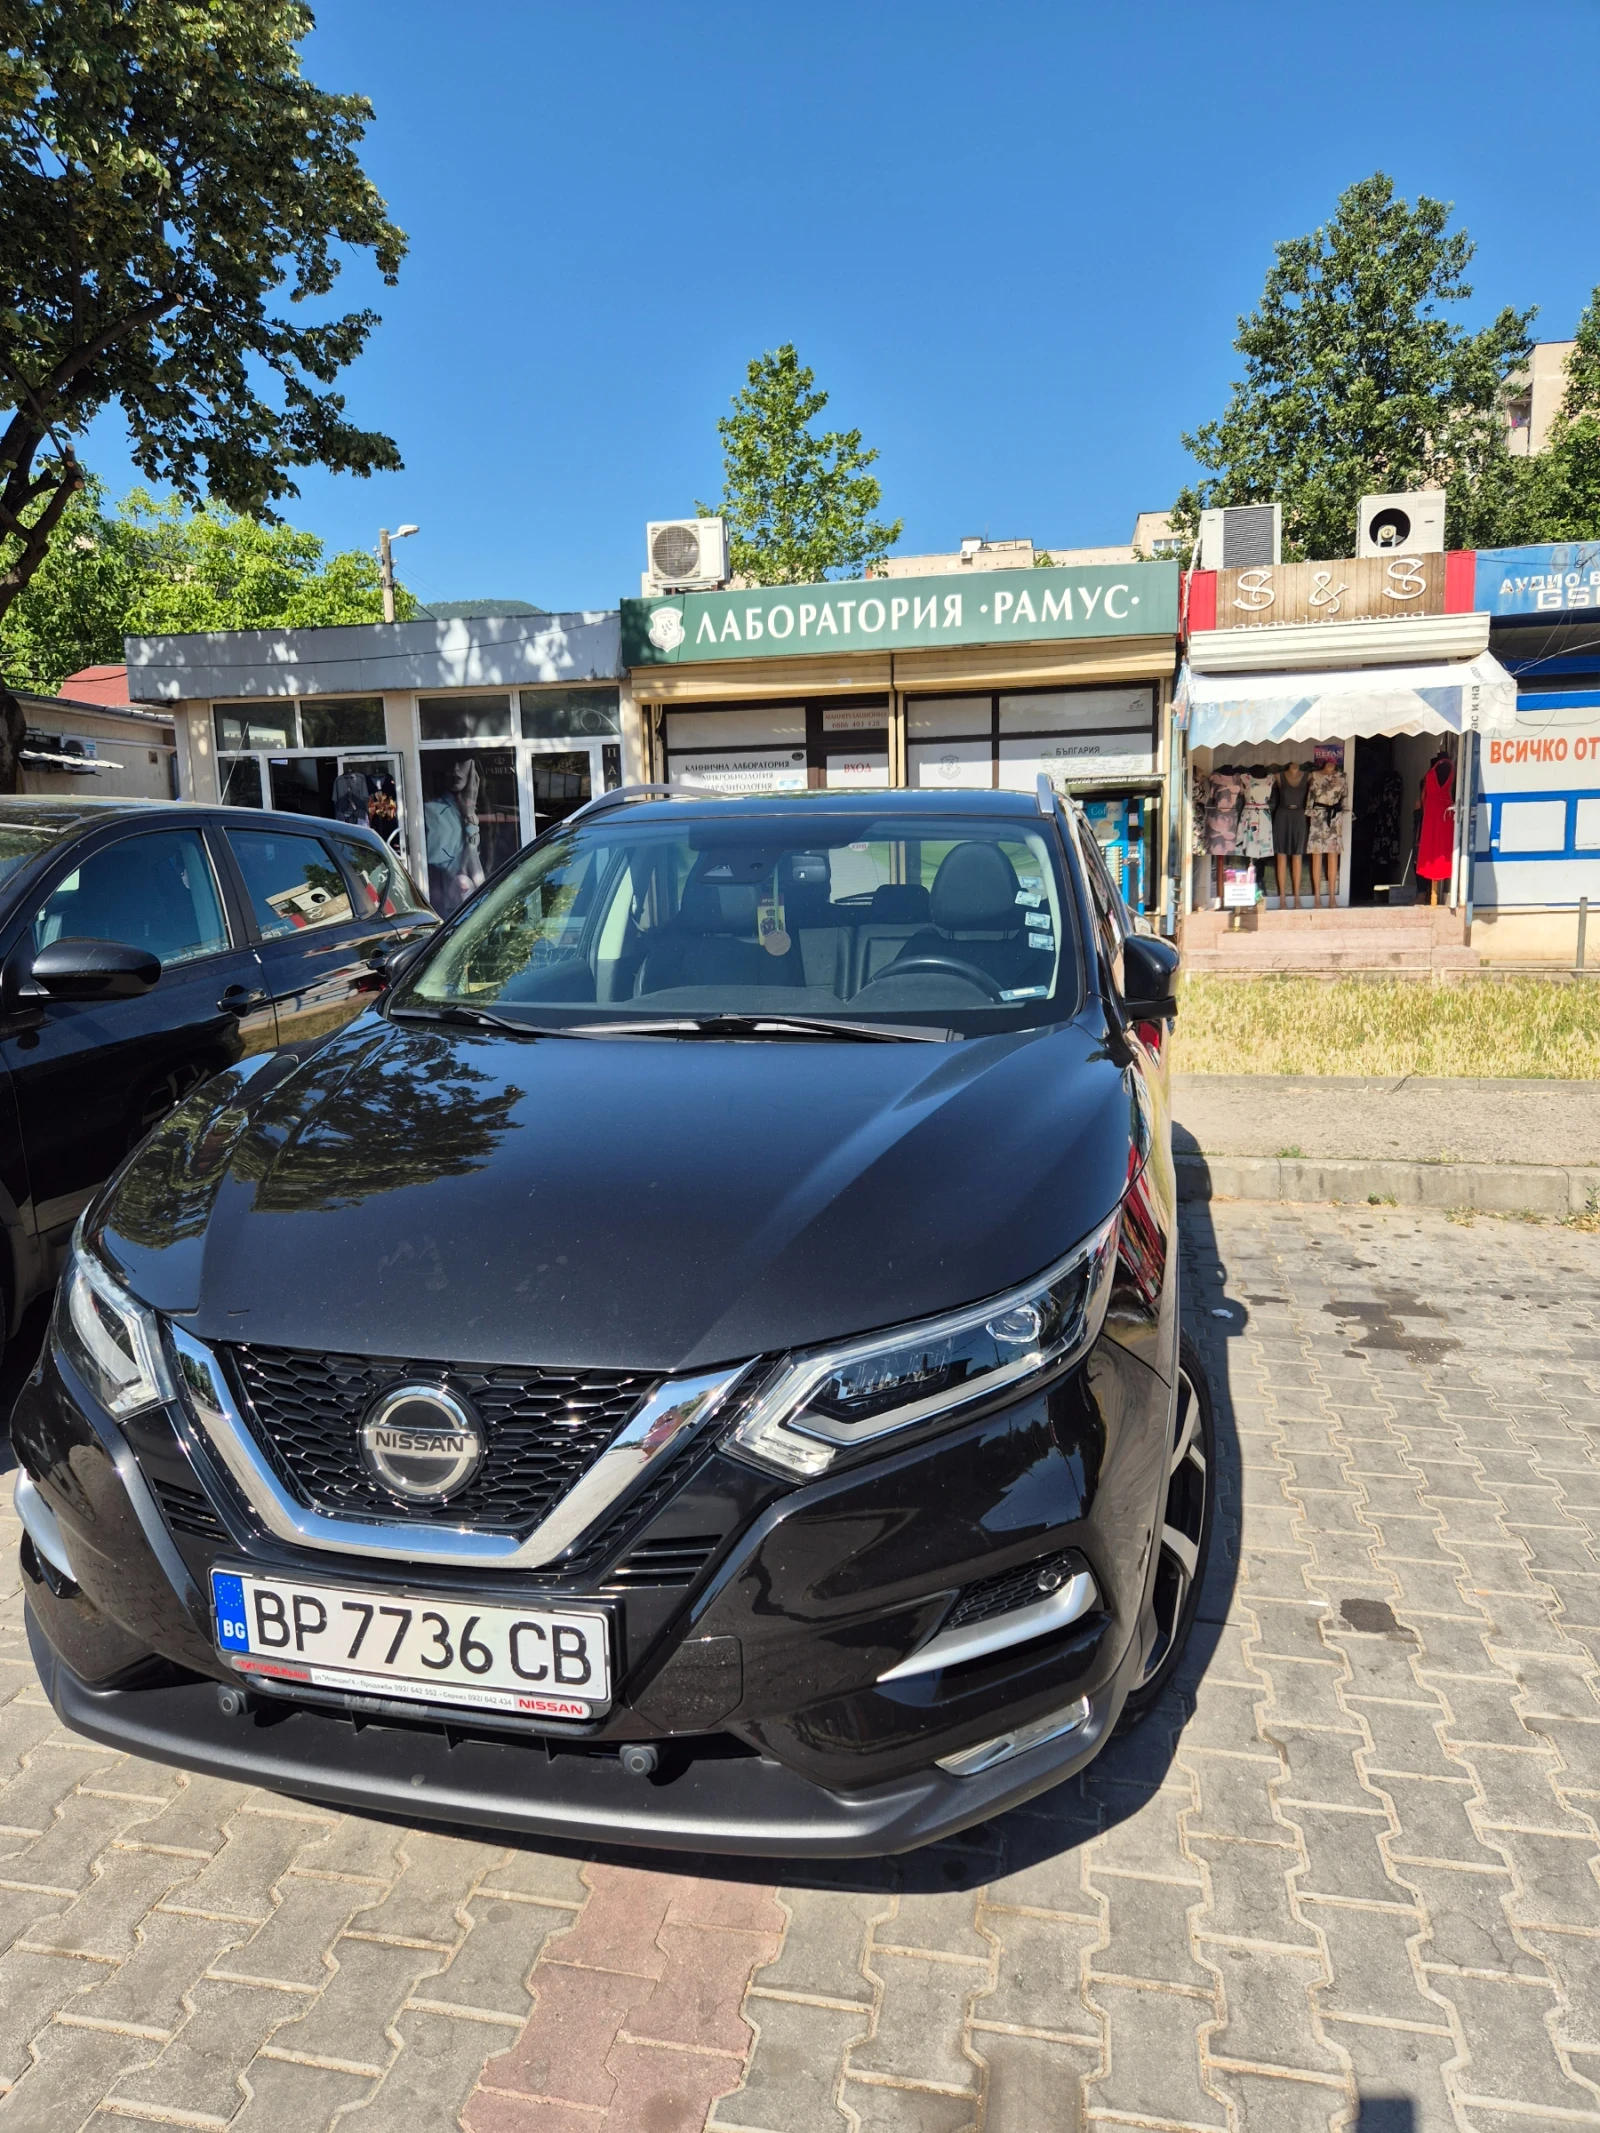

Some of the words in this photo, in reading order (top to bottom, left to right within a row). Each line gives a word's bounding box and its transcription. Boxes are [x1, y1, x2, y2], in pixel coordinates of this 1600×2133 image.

[1232, 569, 1276, 612] S
[1308, 571, 1350, 614] &
[1381, 558, 1427, 600] S
[696, 593, 962, 644] ЛАБОРАТОРИЯ
[1055, 746, 1100, 756] БЪЛГАРИЯ
[1315, 749, 1343, 759] REFAN
[1490, 738, 1568, 764] ВСИЧКО
[1573, 736, 1600, 761] ОТ
[685, 763, 730, 772] КЛИНИЧНА
[732, 760, 790, 771] ЛАБОРАТОРИЯ
[843, 762, 872, 773] ВХОД
[701, 772, 774, 781] МИКРОБИОЛОГИЯ
[1090, 806, 1119, 816] Coffee
[375, 1431, 464, 1452] NISSAN
[223, 1619, 246, 1640] BG
[341, 1601, 494, 1675] 7736
[424, 1688, 437, 1697] 552
[518, 1698, 583, 1715] NISSAN
